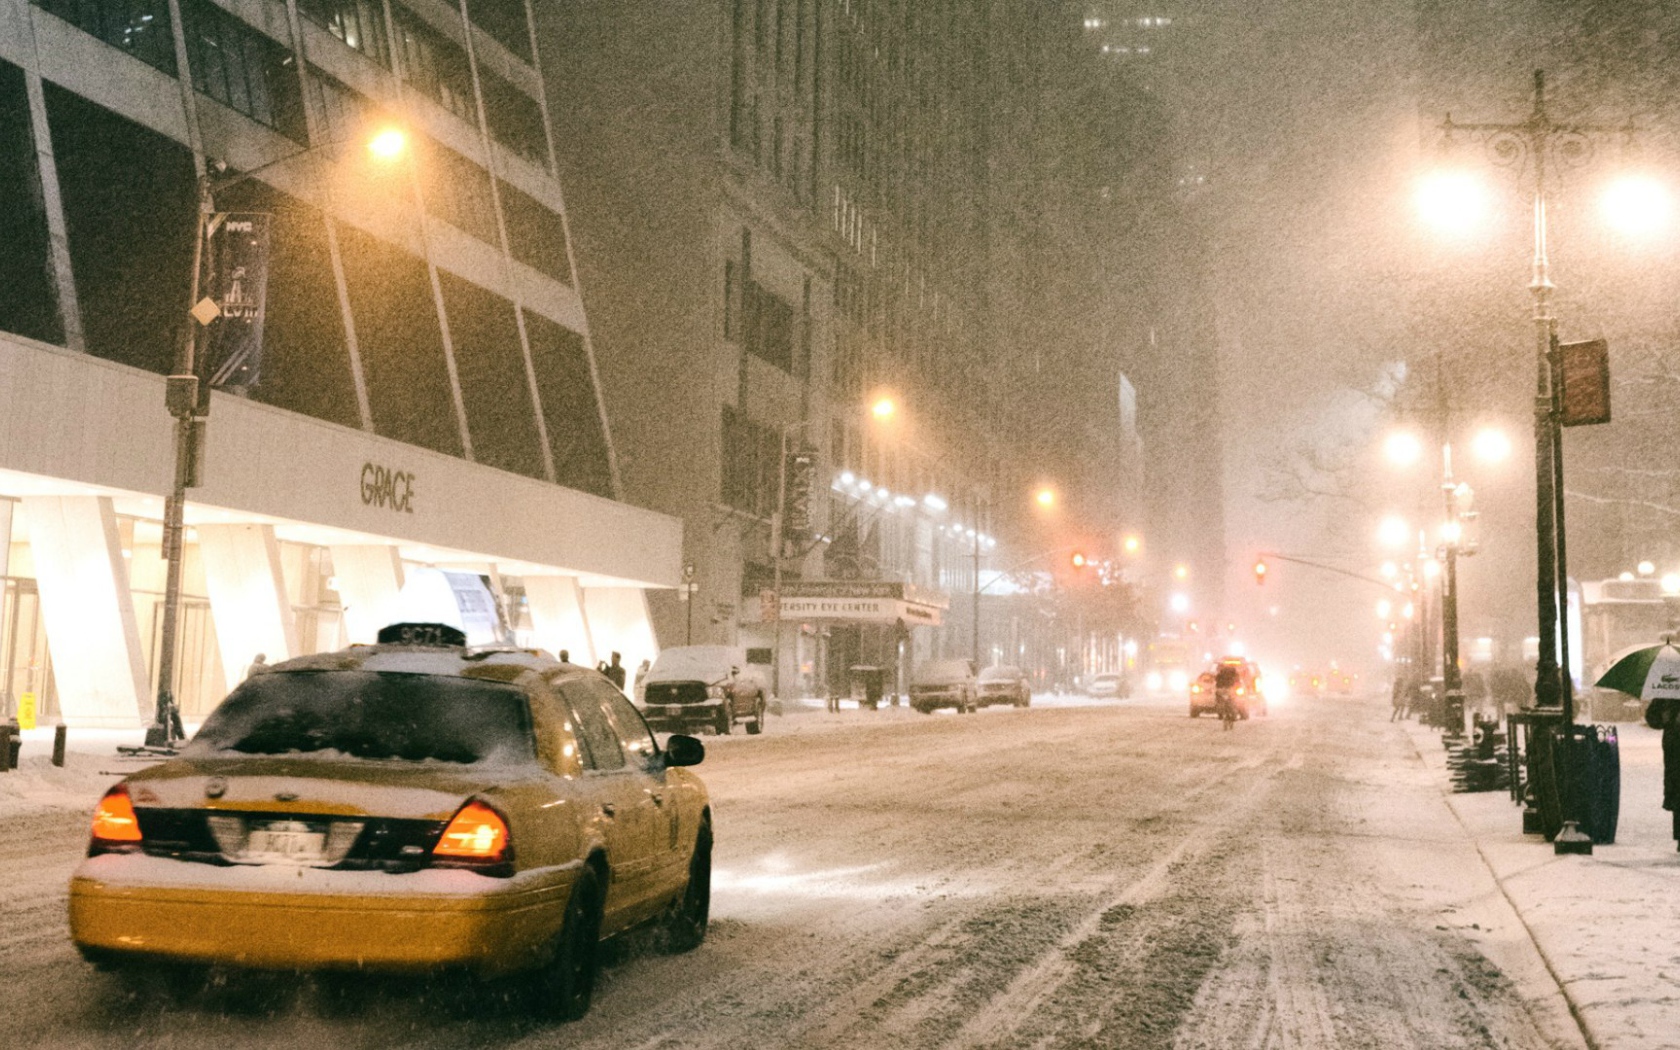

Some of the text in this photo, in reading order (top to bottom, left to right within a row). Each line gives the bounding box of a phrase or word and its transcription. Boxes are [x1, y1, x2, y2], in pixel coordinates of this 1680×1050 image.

[361, 462, 415, 513] GRACE
[821, 602, 838, 611] EYE
[842, 602, 879, 612] CENTER
